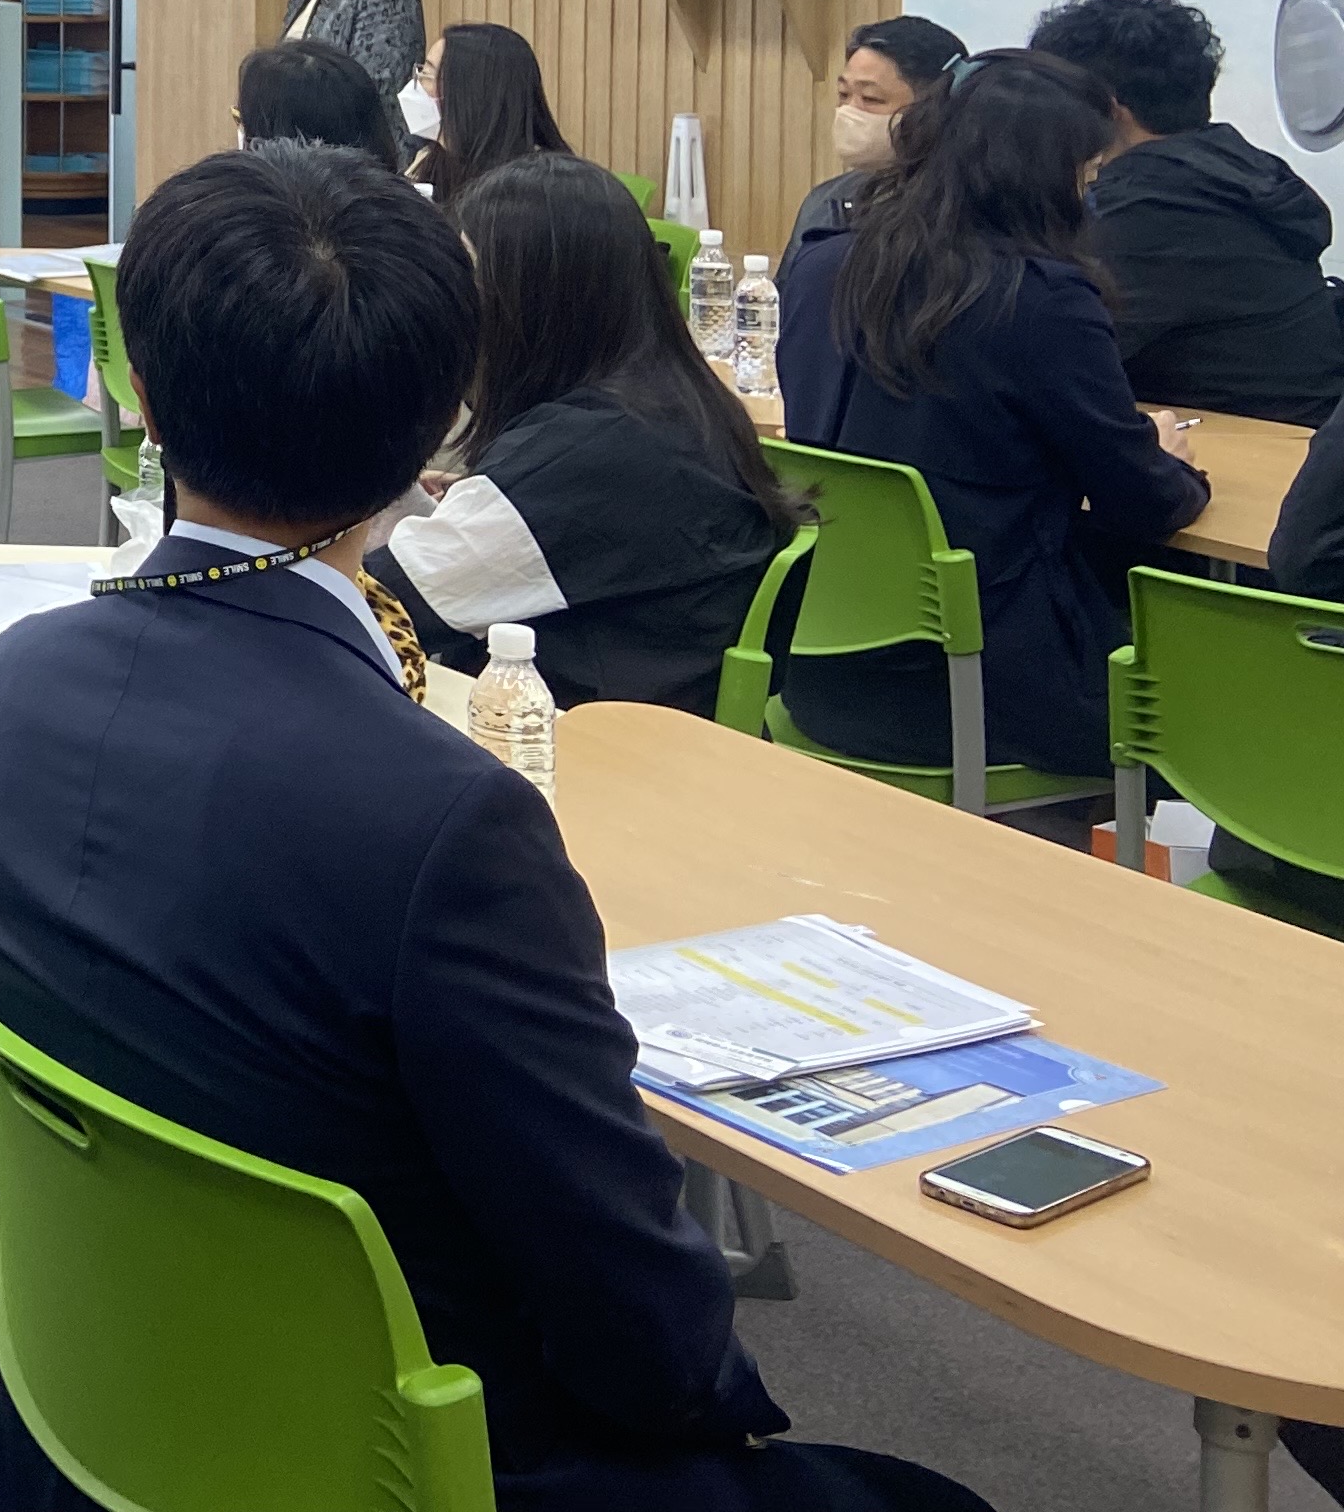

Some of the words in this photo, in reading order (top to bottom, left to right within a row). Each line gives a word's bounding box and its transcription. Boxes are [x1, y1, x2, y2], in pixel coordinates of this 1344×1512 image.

[270, 551, 295, 566] SMILE
[223, 562, 250, 576] SMILE
[178, 571, 204, 585] SMILE
